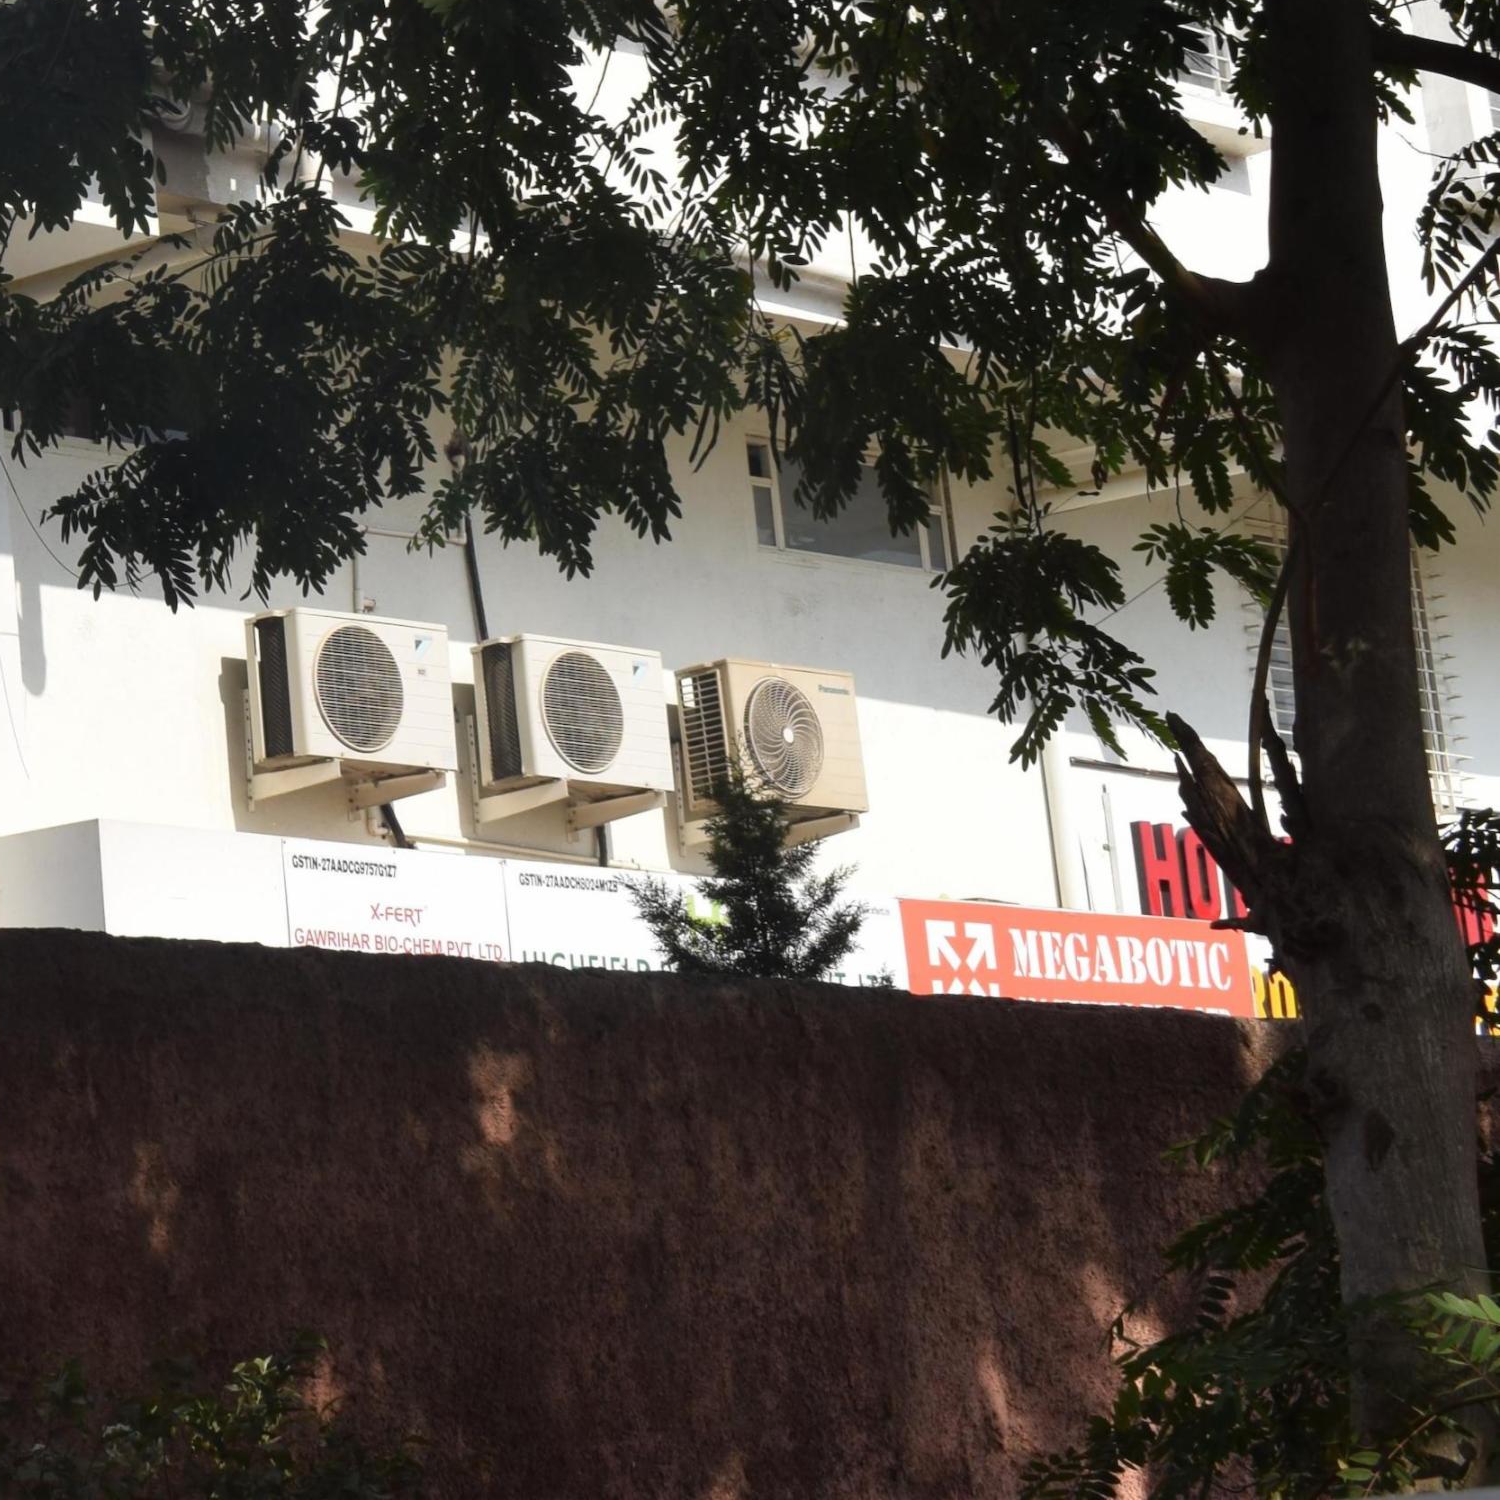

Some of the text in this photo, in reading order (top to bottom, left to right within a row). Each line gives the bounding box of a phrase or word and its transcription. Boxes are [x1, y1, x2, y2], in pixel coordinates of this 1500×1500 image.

[370, 903, 423, 927] X-FERT
[294, 927, 370, 950] GAWRIHAR
[375, 934, 442, 955] BIO-CHEM
[1008, 928, 1232, 991] MEGABOTIC
